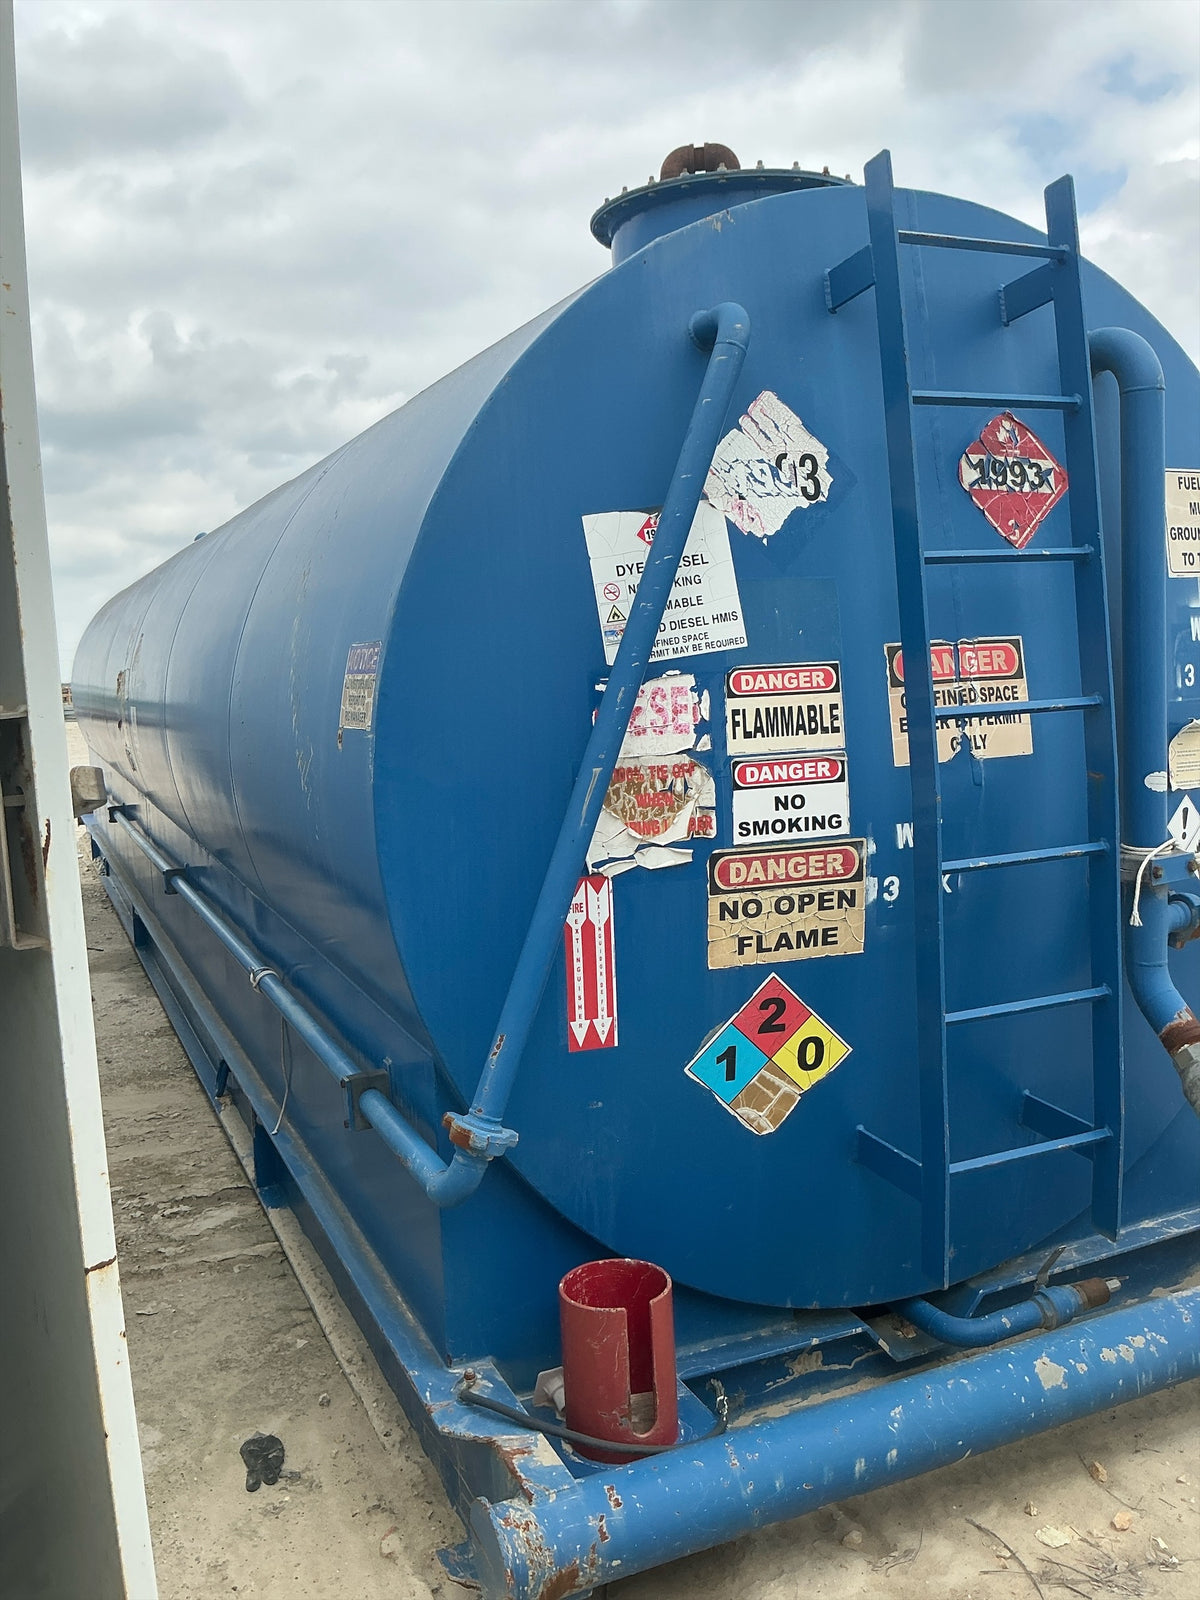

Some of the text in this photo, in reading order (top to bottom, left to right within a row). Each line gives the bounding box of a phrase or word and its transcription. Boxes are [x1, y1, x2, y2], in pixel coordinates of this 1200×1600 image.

[972, 459, 1045, 488] 1993
[646, 529, 656, 540] 19
[616, 553, 709, 577] DYE SEL
[1182, 552, 1195, 566] TO
[674, 574, 702, 588] KING
[664, 595, 704, 611] MABLE
[669, 616, 709, 631] DIESEL
[711, 611, 739, 625] HMIS
[650, 636, 745, 659] RMIT MAY BE REQUIRED
[653, 632, 710, 648] FINED SPACE
[347, 648, 379, 671] NOTICE
[931, 650, 1008, 675] ANGER
[740, 671, 826, 691] DANGER
[980, 685, 1019, 702] SPACE
[731, 703, 841, 740] FLAMMABLE
[950, 734, 988, 752] OLY
[745, 761, 831, 783] DANGER
[634, 791, 674, 808] WHEN
[774, 794, 806, 811] NO
[738, 814, 842, 837] SMOKING
[729, 853, 844, 884] DANGER
[570, 902, 584, 914] IRE
[719, 889, 857, 921] NO OPEN
[737, 926, 839, 956] FLAME
[574, 918, 583, 1029] EXTINGUISHER
[757, 997, 787, 1035] 2
[715, 1045, 737, 1082] 1
[797, 1036, 825, 1072] 0
